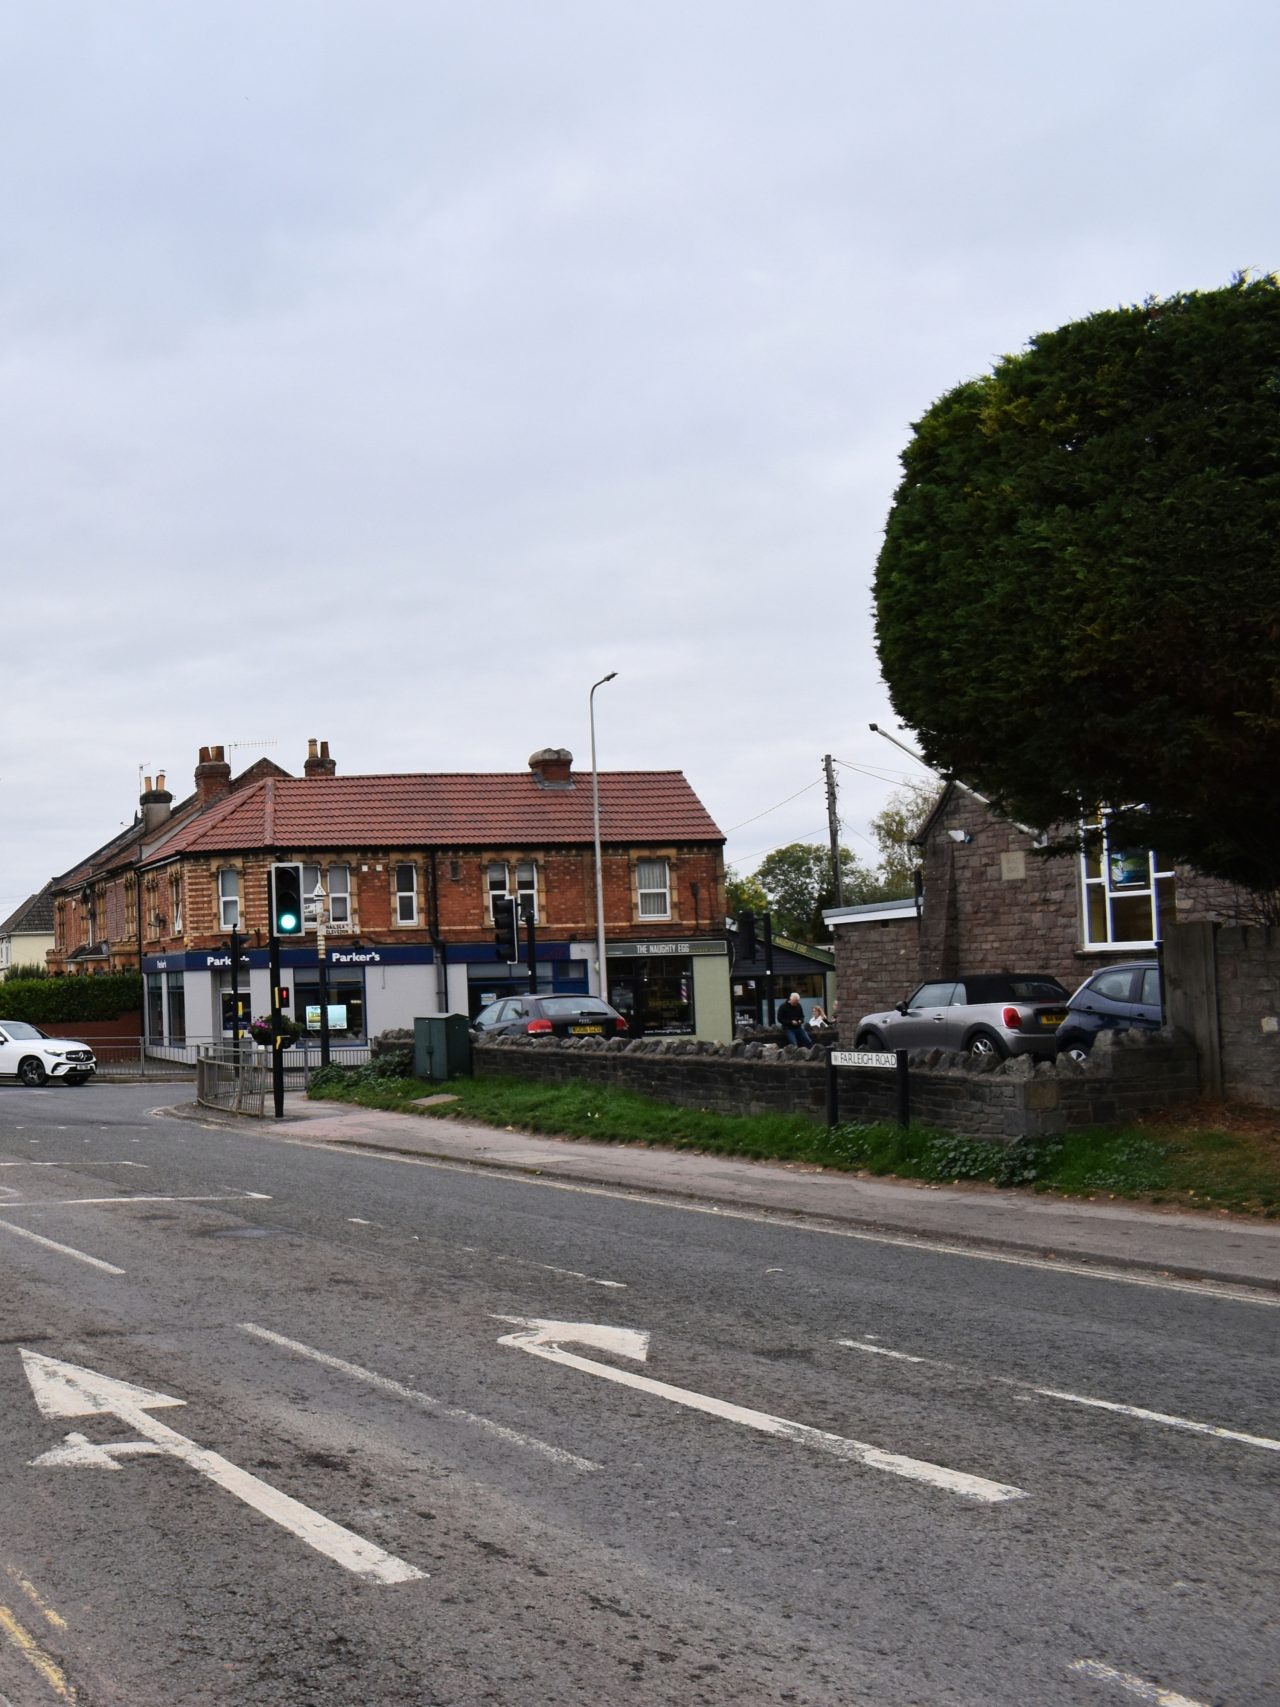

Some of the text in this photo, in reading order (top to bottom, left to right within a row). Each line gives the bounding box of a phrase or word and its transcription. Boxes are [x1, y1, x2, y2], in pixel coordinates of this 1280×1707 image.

[636, 943, 690, 954] THE NAUGHTY EGG
[331, 951, 381, 962] Parker's
[840, 1052, 897, 1066] FARLEIGH ROAD
